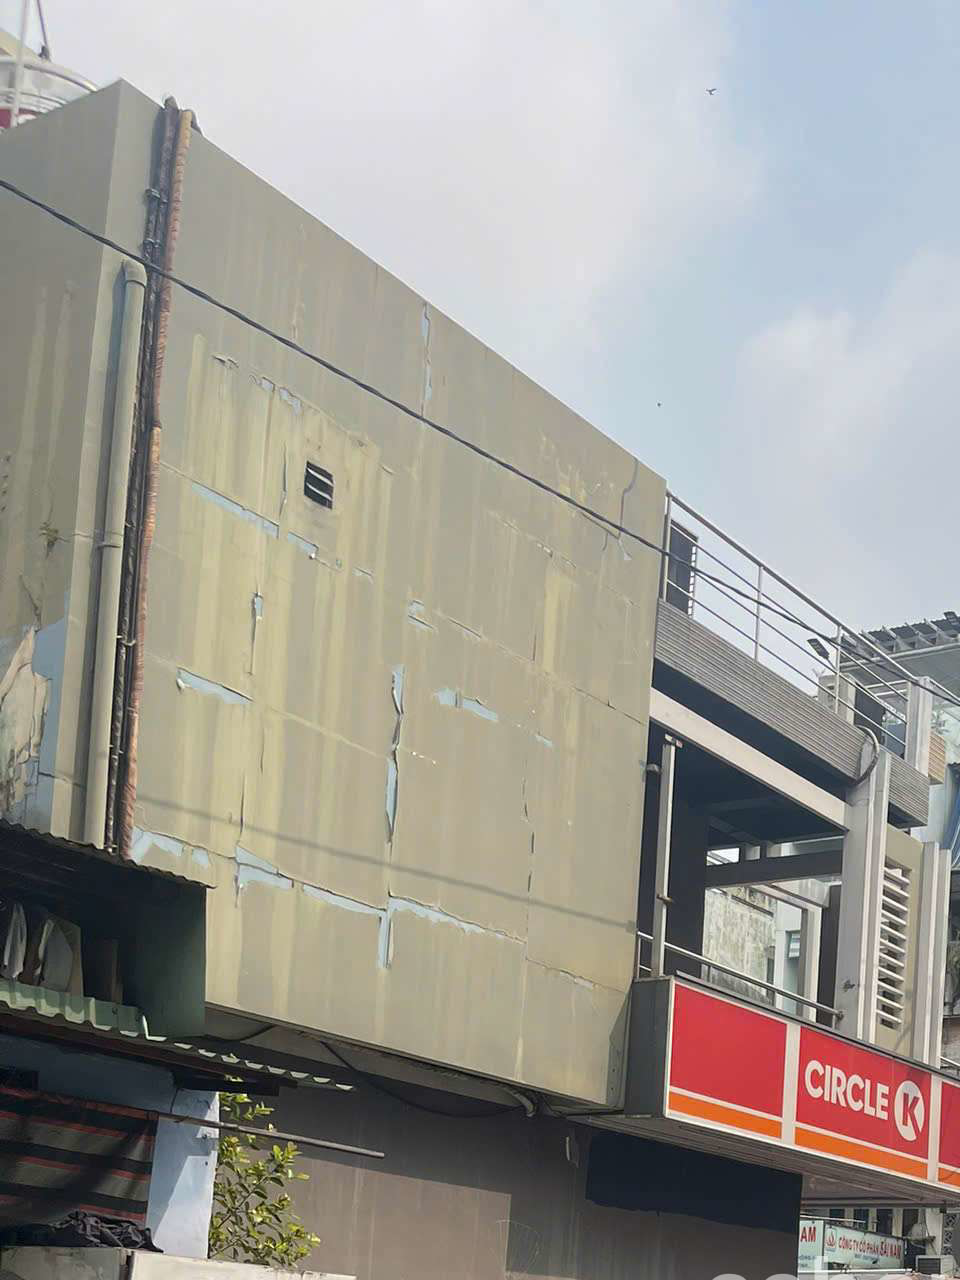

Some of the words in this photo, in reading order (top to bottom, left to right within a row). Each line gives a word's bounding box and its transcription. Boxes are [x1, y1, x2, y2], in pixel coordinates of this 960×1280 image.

[804, 1060, 889, 1120] CIRCLE
[900, 1089, 922, 1138] K
[800, 1226, 816, 1243] AM
